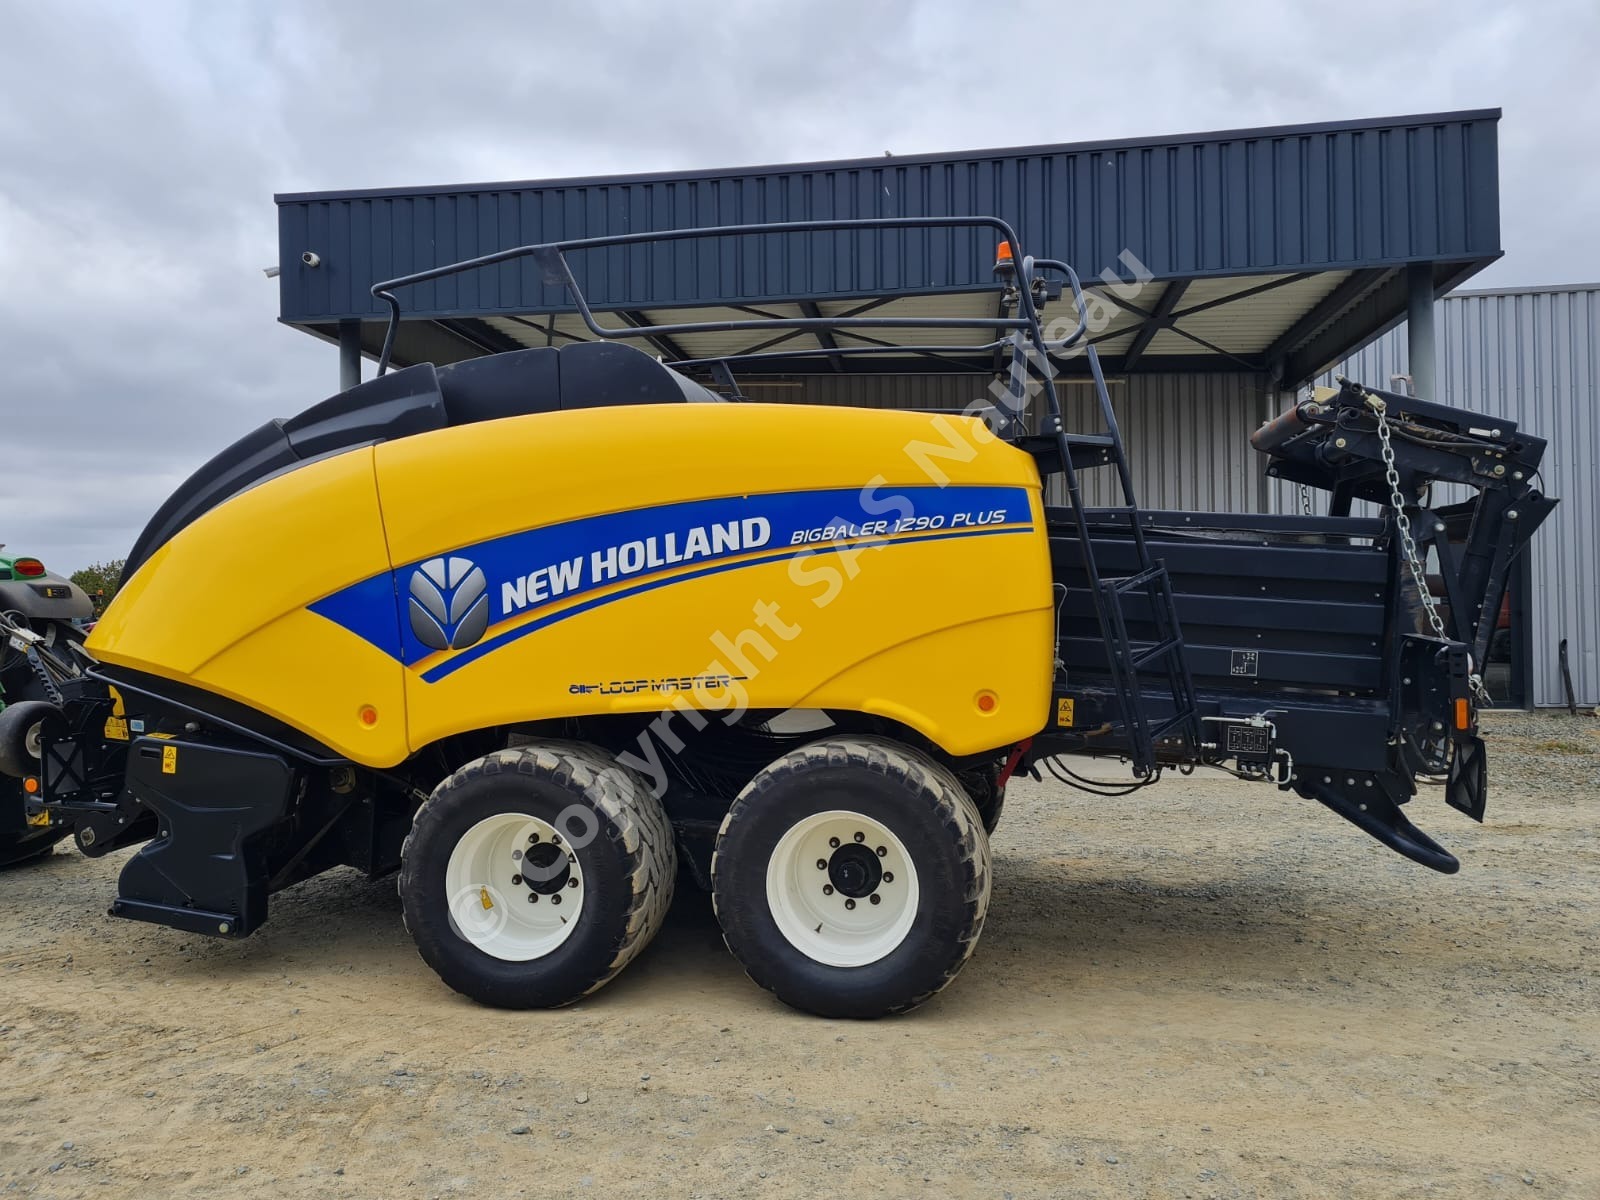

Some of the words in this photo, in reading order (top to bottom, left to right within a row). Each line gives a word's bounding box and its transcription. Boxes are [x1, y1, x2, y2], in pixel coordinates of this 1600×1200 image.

[790, 520, 888, 545] BIGBALER
[893, 515, 945, 532] 1290
[951, 510, 1007, 527] PLUS
[502, 556, 584, 615] NEW
[591, 517, 771, 583] HOLLAND
